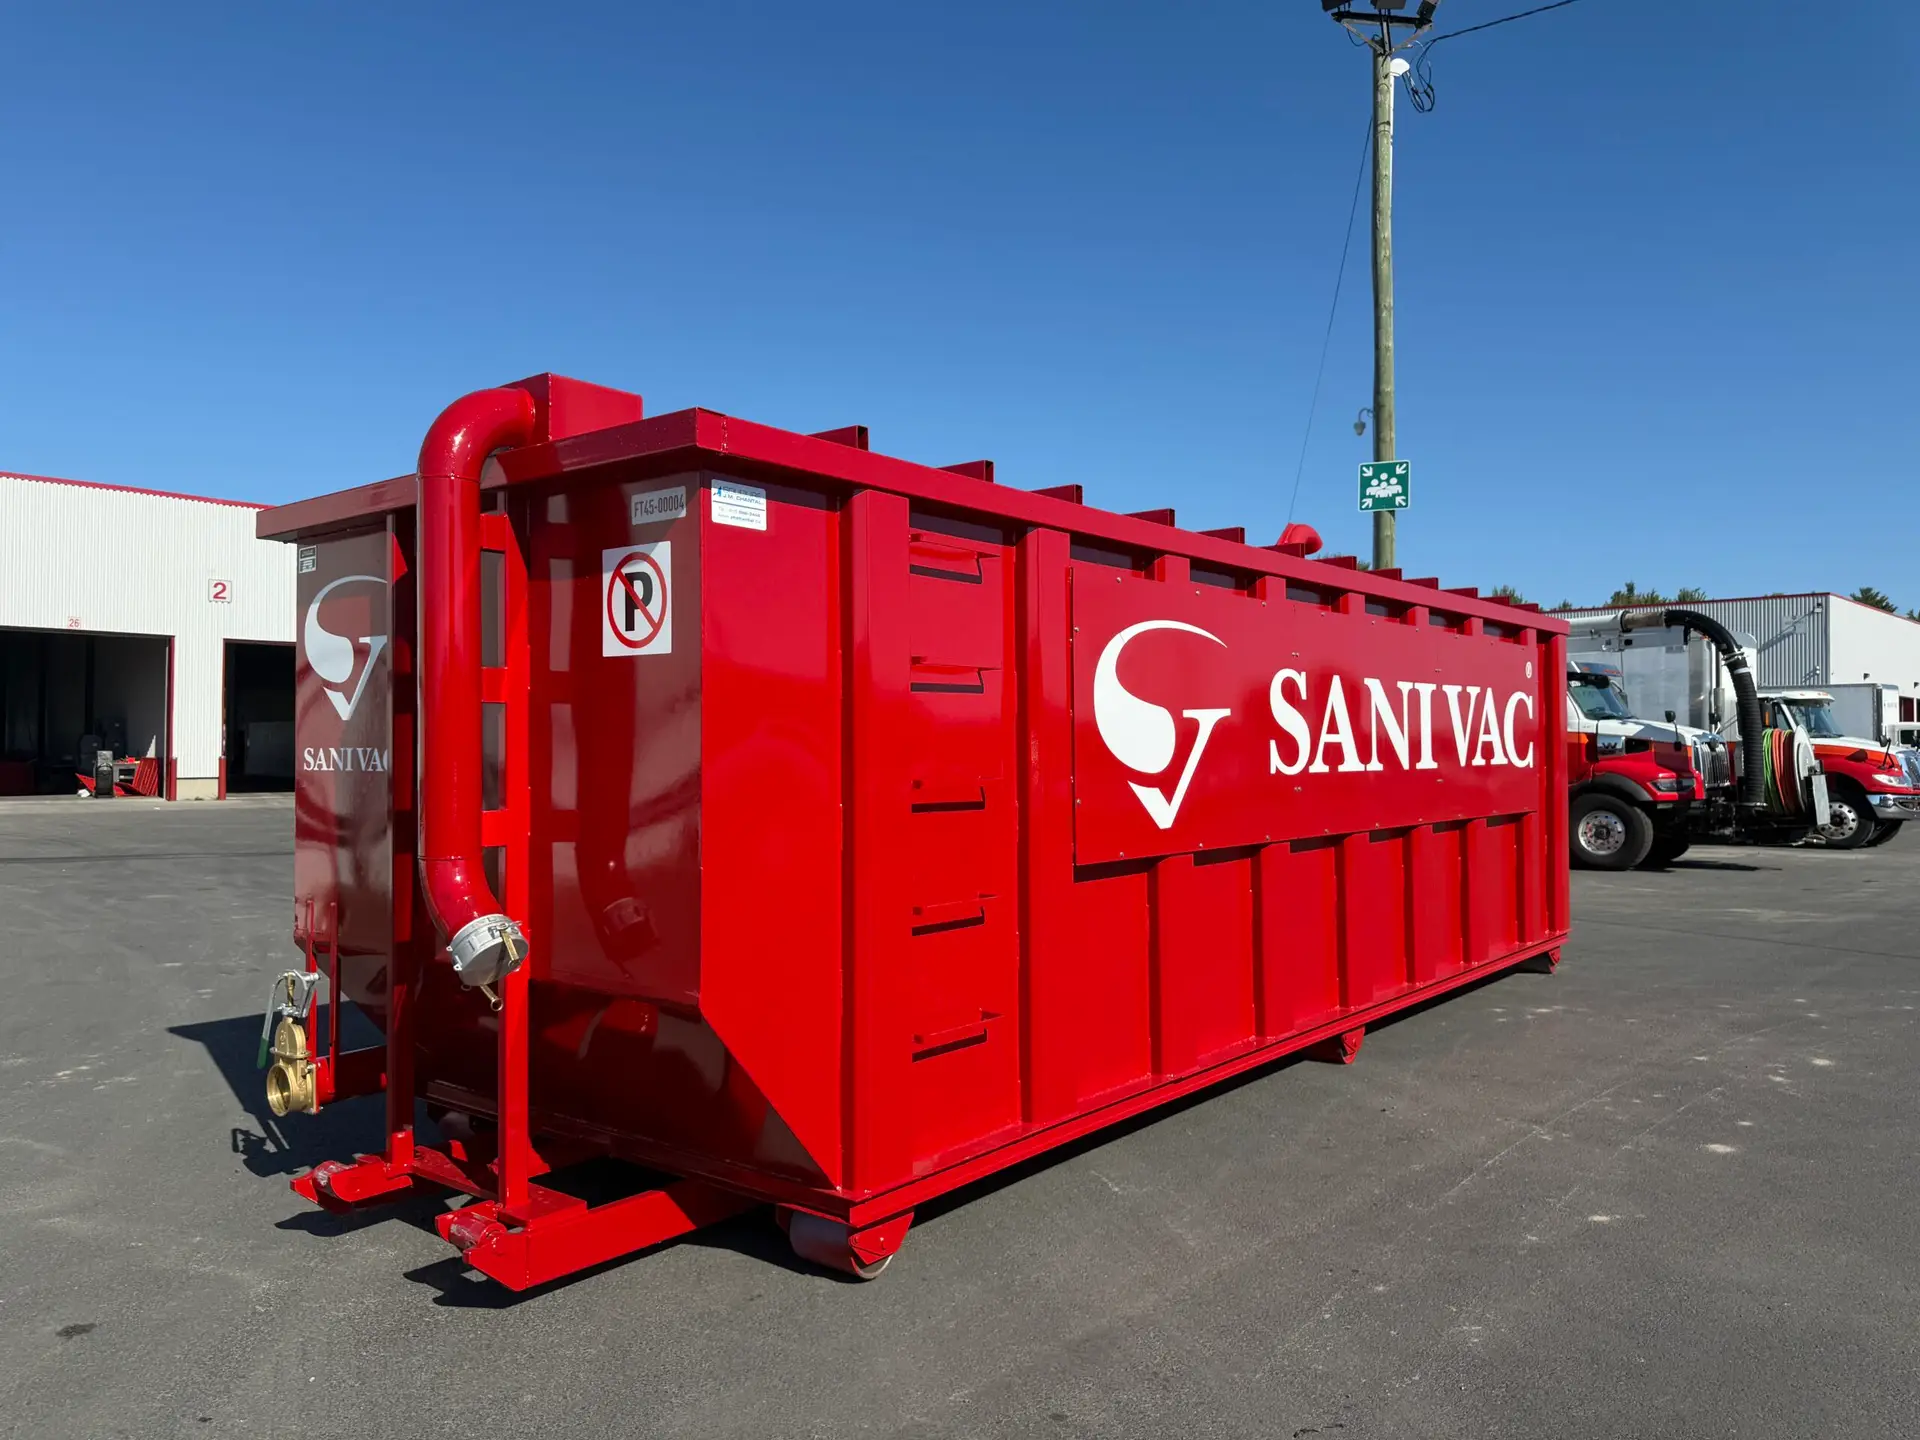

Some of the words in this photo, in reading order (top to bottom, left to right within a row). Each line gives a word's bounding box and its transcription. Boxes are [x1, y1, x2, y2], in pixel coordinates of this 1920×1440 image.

[634, 494, 685, 518] FT45-00004
[212, 582, 227, 600] 2
[69, 619, 80, 628] 26
